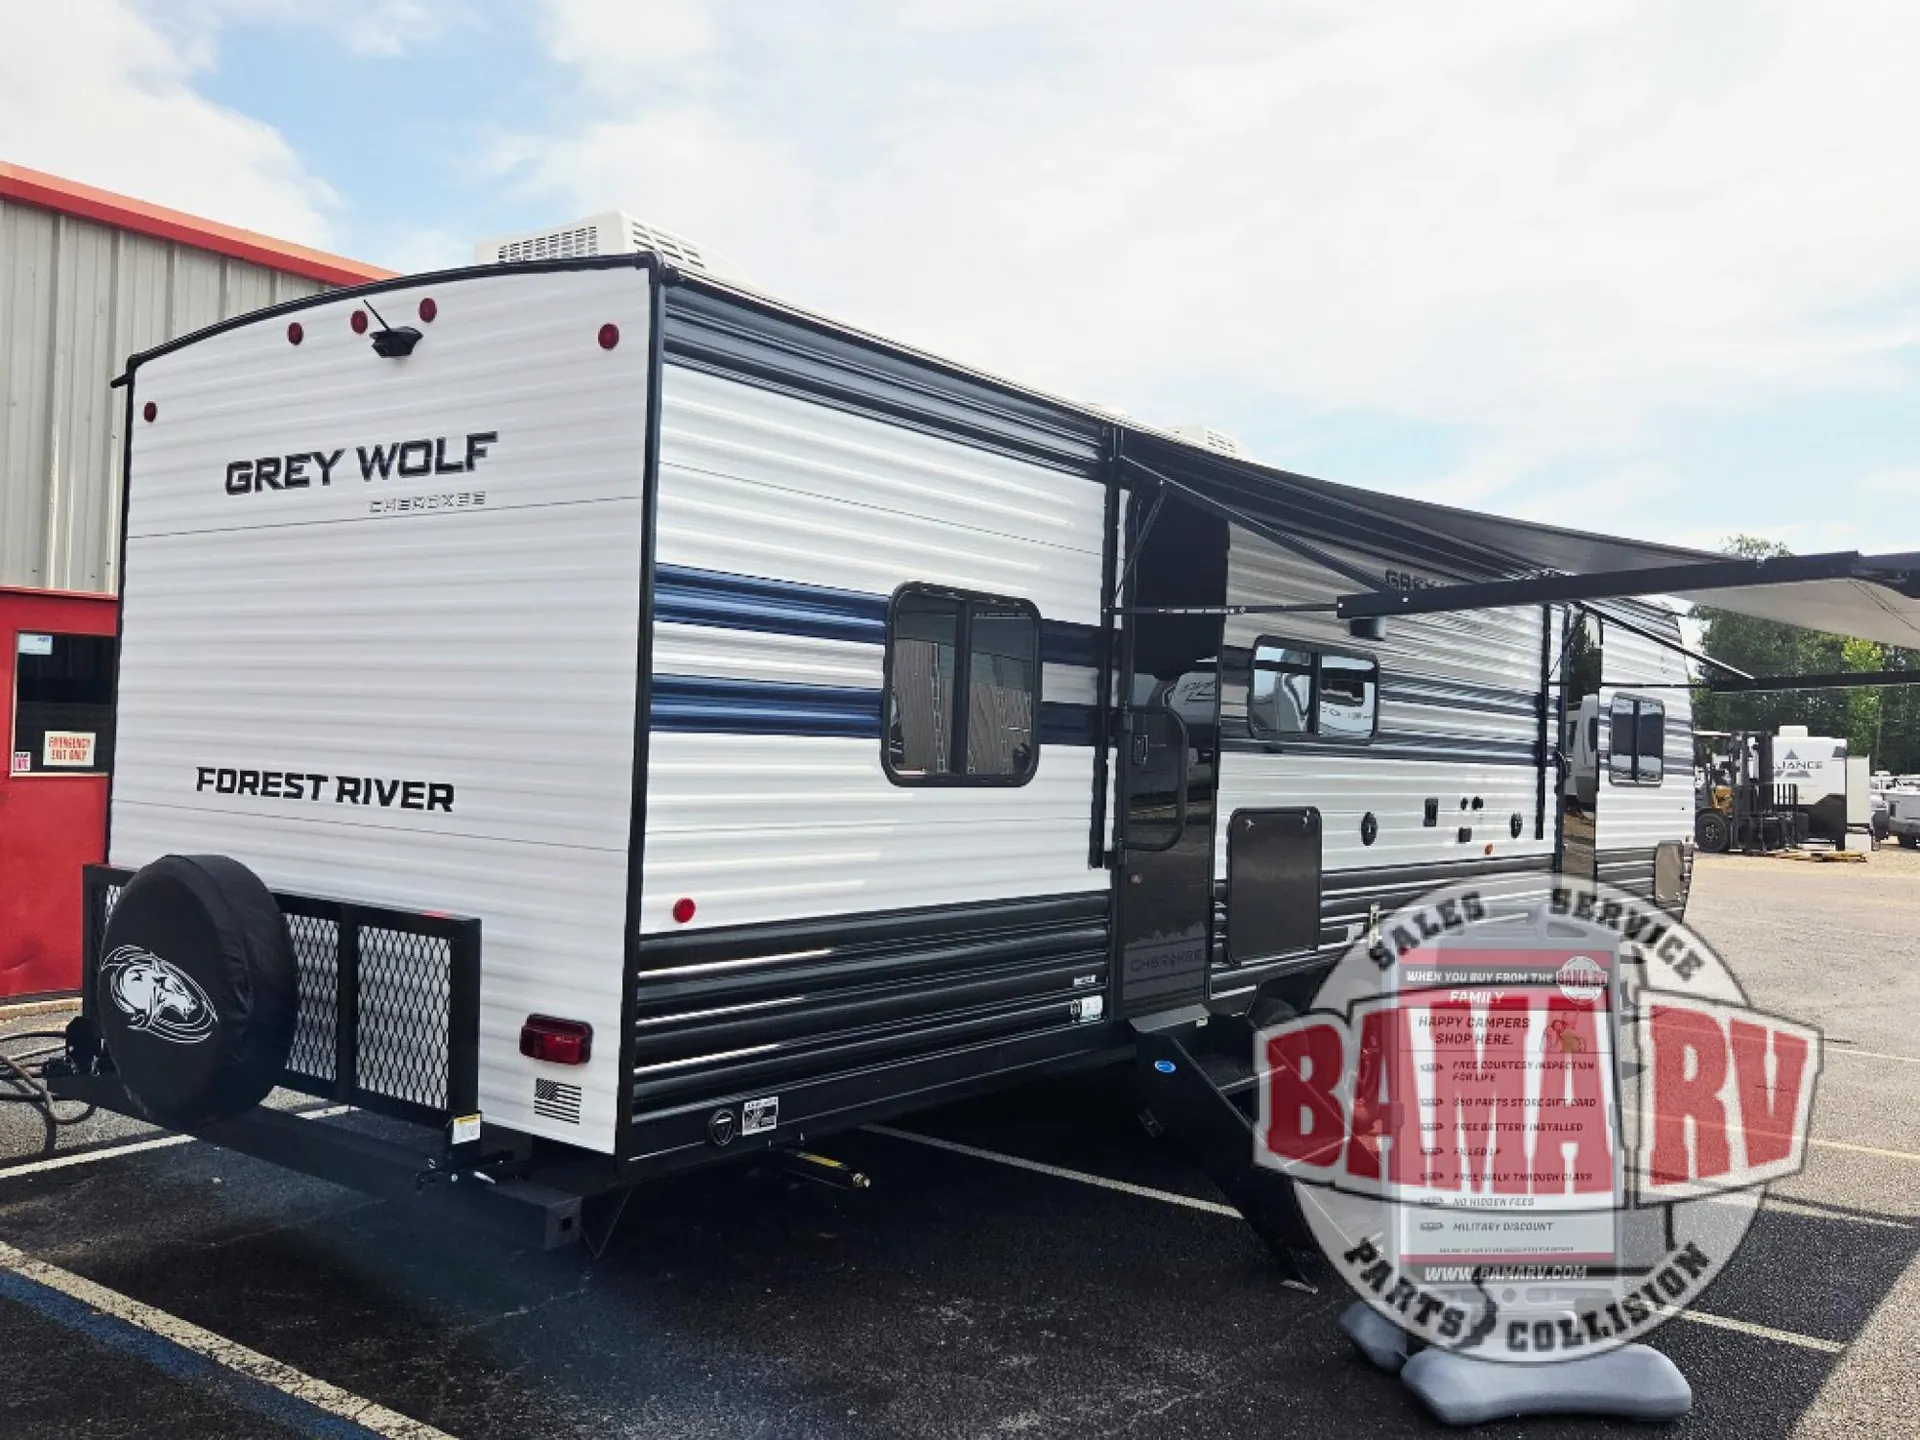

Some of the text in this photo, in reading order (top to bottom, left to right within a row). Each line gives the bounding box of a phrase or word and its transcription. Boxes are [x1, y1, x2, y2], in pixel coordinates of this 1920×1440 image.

[226, 431, 498, 495] GREY WOLF
[369, 491, 486, 513] CHEROKEE
[1772, 760, 1824, 770] LIANCE
[196, 766, 455, 812] FOREST RIVER
[1406, 970, 1554, 984] WHEN YOU BUY FROM THE
[1450, 991, 1505, 1004] FAMILY
[1418, 1016, 1530, 1029] HAPPY CAMPERS
[1436, 1033, 1513, 1046] SHOP HERE.
[1452, 1060, 1478, 1070] FREE
[1480, 1060, 1533, 1070] COURTESY
[1452, 1072, 1497, 1082] FOR LIFE
[1475, 1098, 1508, 1108] PARTS
[1510, 1098, 1544, 1108] STORE
[1545, 1098, 1569, 1107] GIFT
[1452, 1122, 1479, 1132] FREE
[1528, 1122, 1583, 1132] INSTALLED
[1452, 1197, 1534, 1207] NO HIDDEN FEES
[1452, 1221, 1555, 1232] MILITARY DISCOUNT
[1424, 1265, 1588, 1281] WWW.BAMARV.COM
